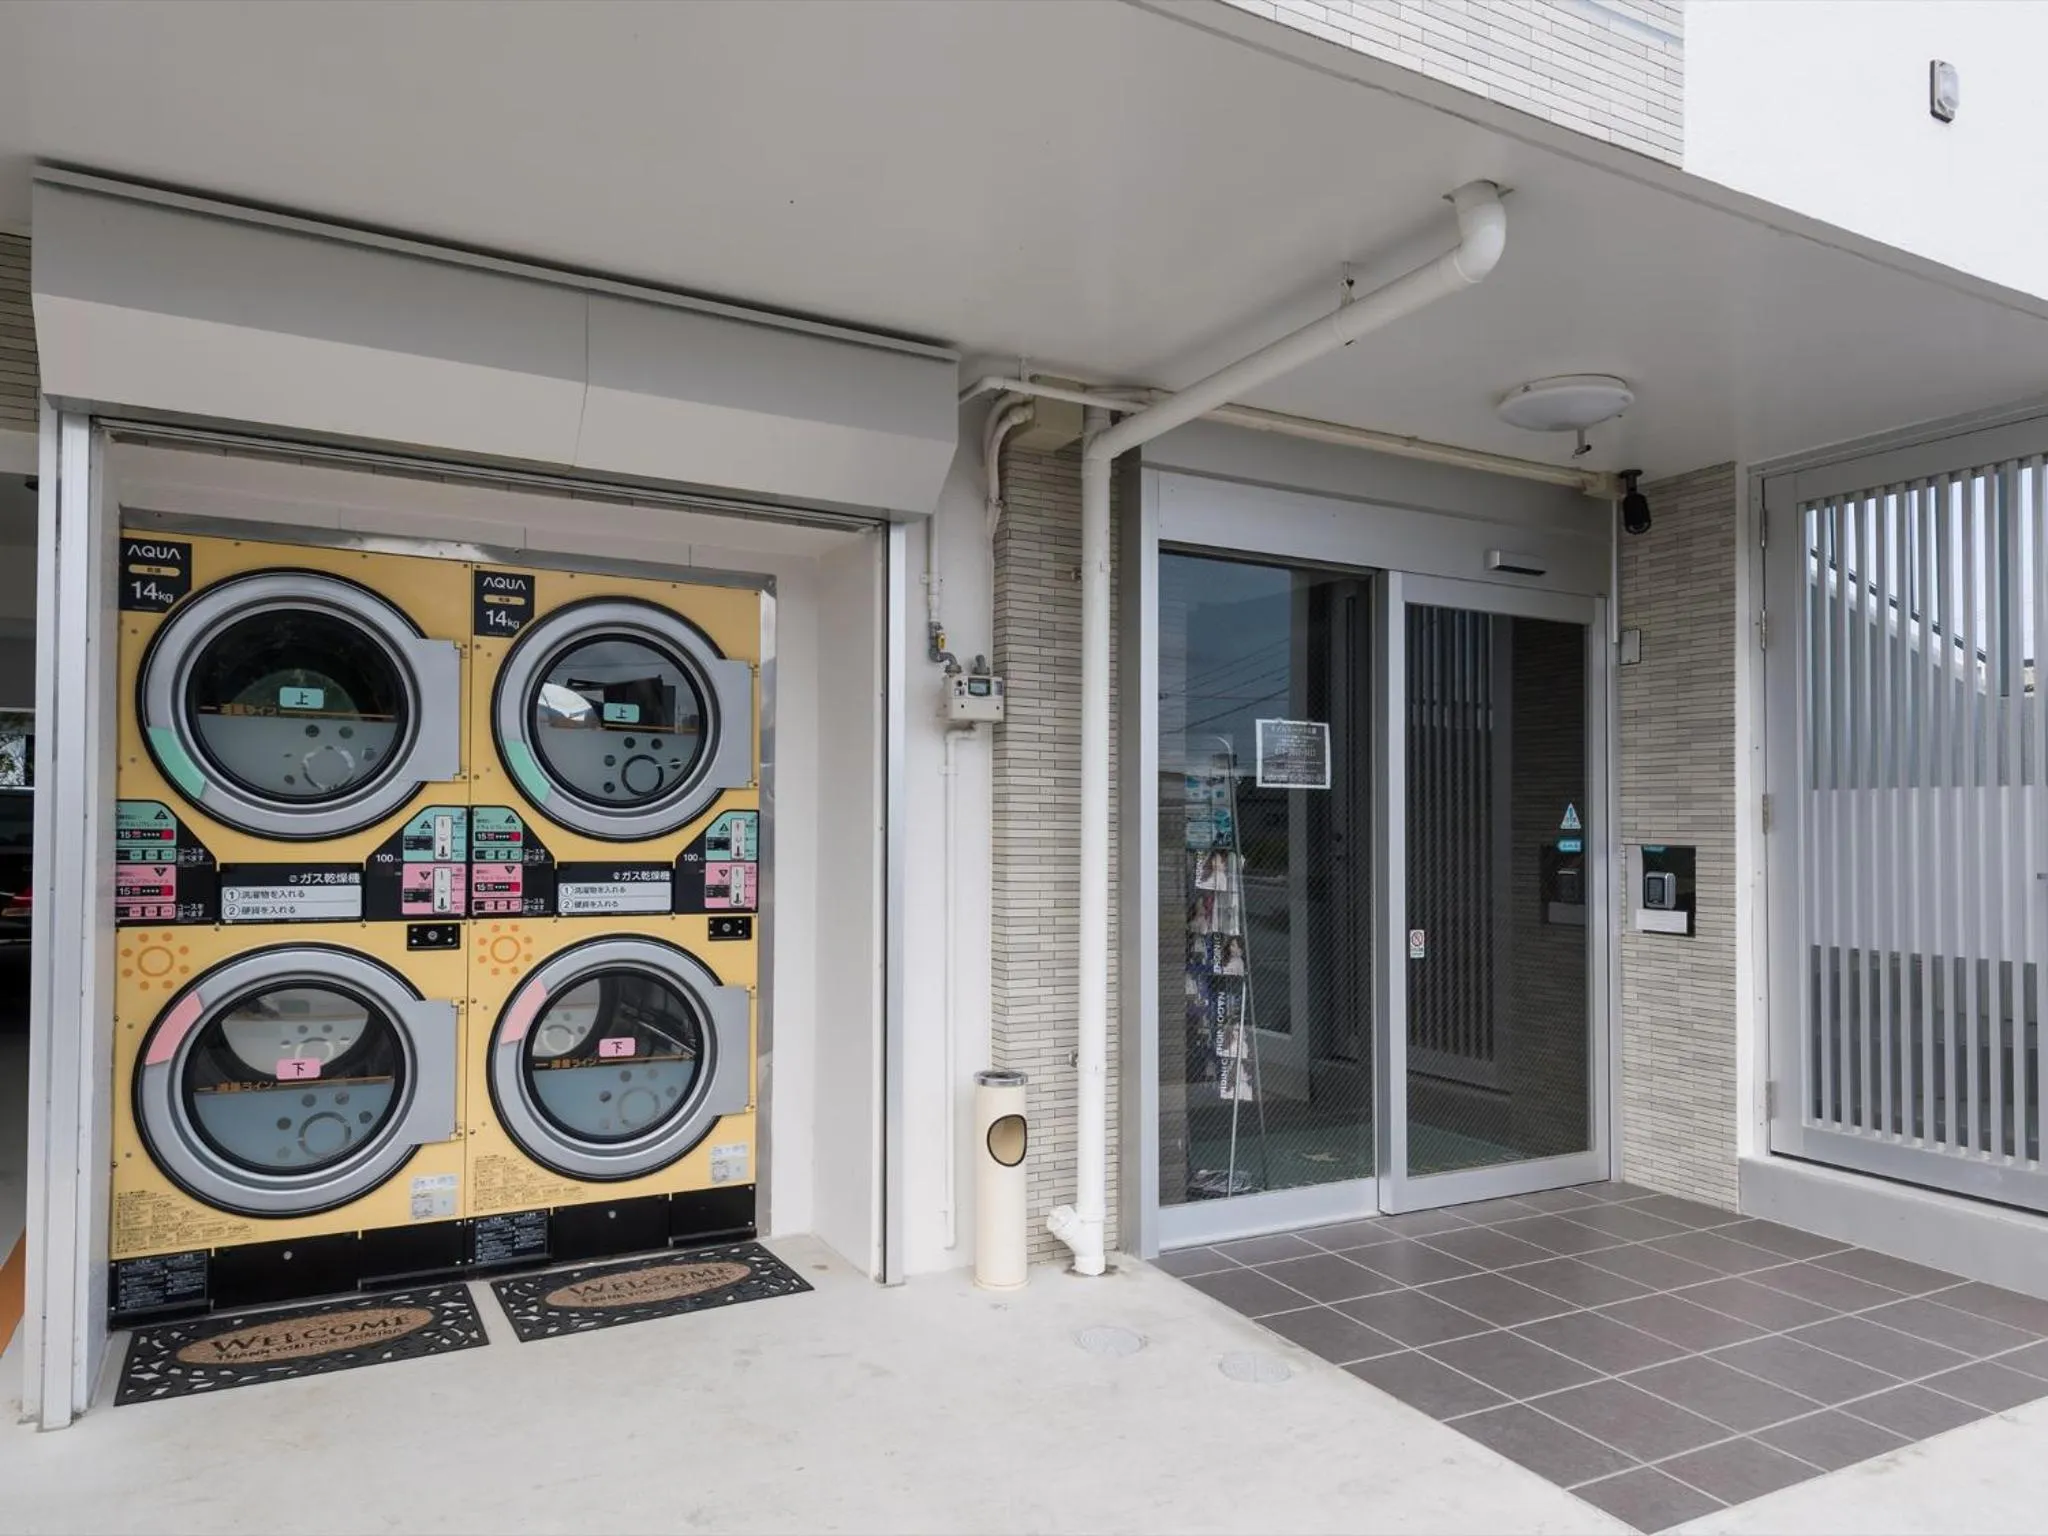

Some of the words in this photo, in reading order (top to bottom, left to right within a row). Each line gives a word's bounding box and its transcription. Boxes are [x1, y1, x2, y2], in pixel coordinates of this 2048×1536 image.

[127, 544, 181, 560] AQUA
[483, 576, 526, 590] AQUA
[131, 581, 174, 603] 14kg
[486, 609, 520, 630] 14kg
[295, 691, 309, 706] 上
[615, 706, 628, 719] 上
[375, 854, 394, 863] 100
[683, 853, 698, 862] 100
[299, 872, 361, 884] ガス乾燥機
[621, 870, 670, 881] ガス乾燥機
[612, 1041, 624, 1054] 下
[292, 1062, 306, 1077] 下
[568, 1264, 732, 1296] WELCOME
[211, 1315, 410, 1352] WELCOME
